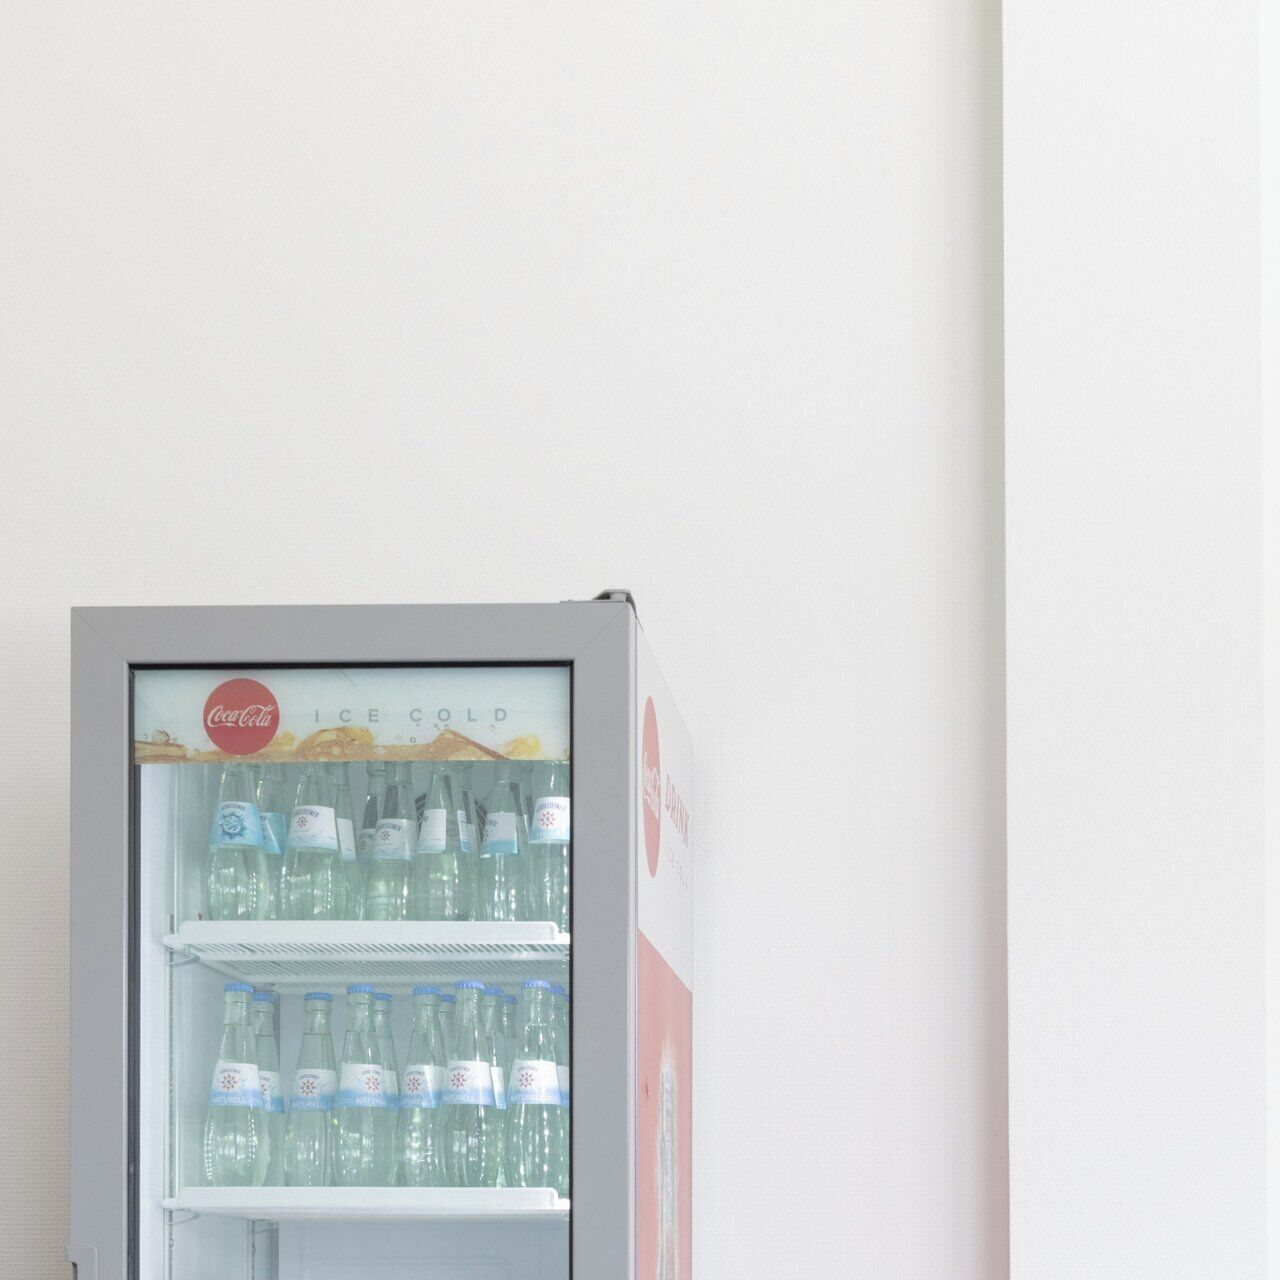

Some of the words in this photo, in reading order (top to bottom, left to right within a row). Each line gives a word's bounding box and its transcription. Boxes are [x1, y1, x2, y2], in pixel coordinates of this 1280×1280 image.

[207, 704, 275, 728] Coca-Cola
[315, 708, 380, 723] ICE
[409, 708, 508, 723] COLD
[665, 771, 690, 848] DRINK
